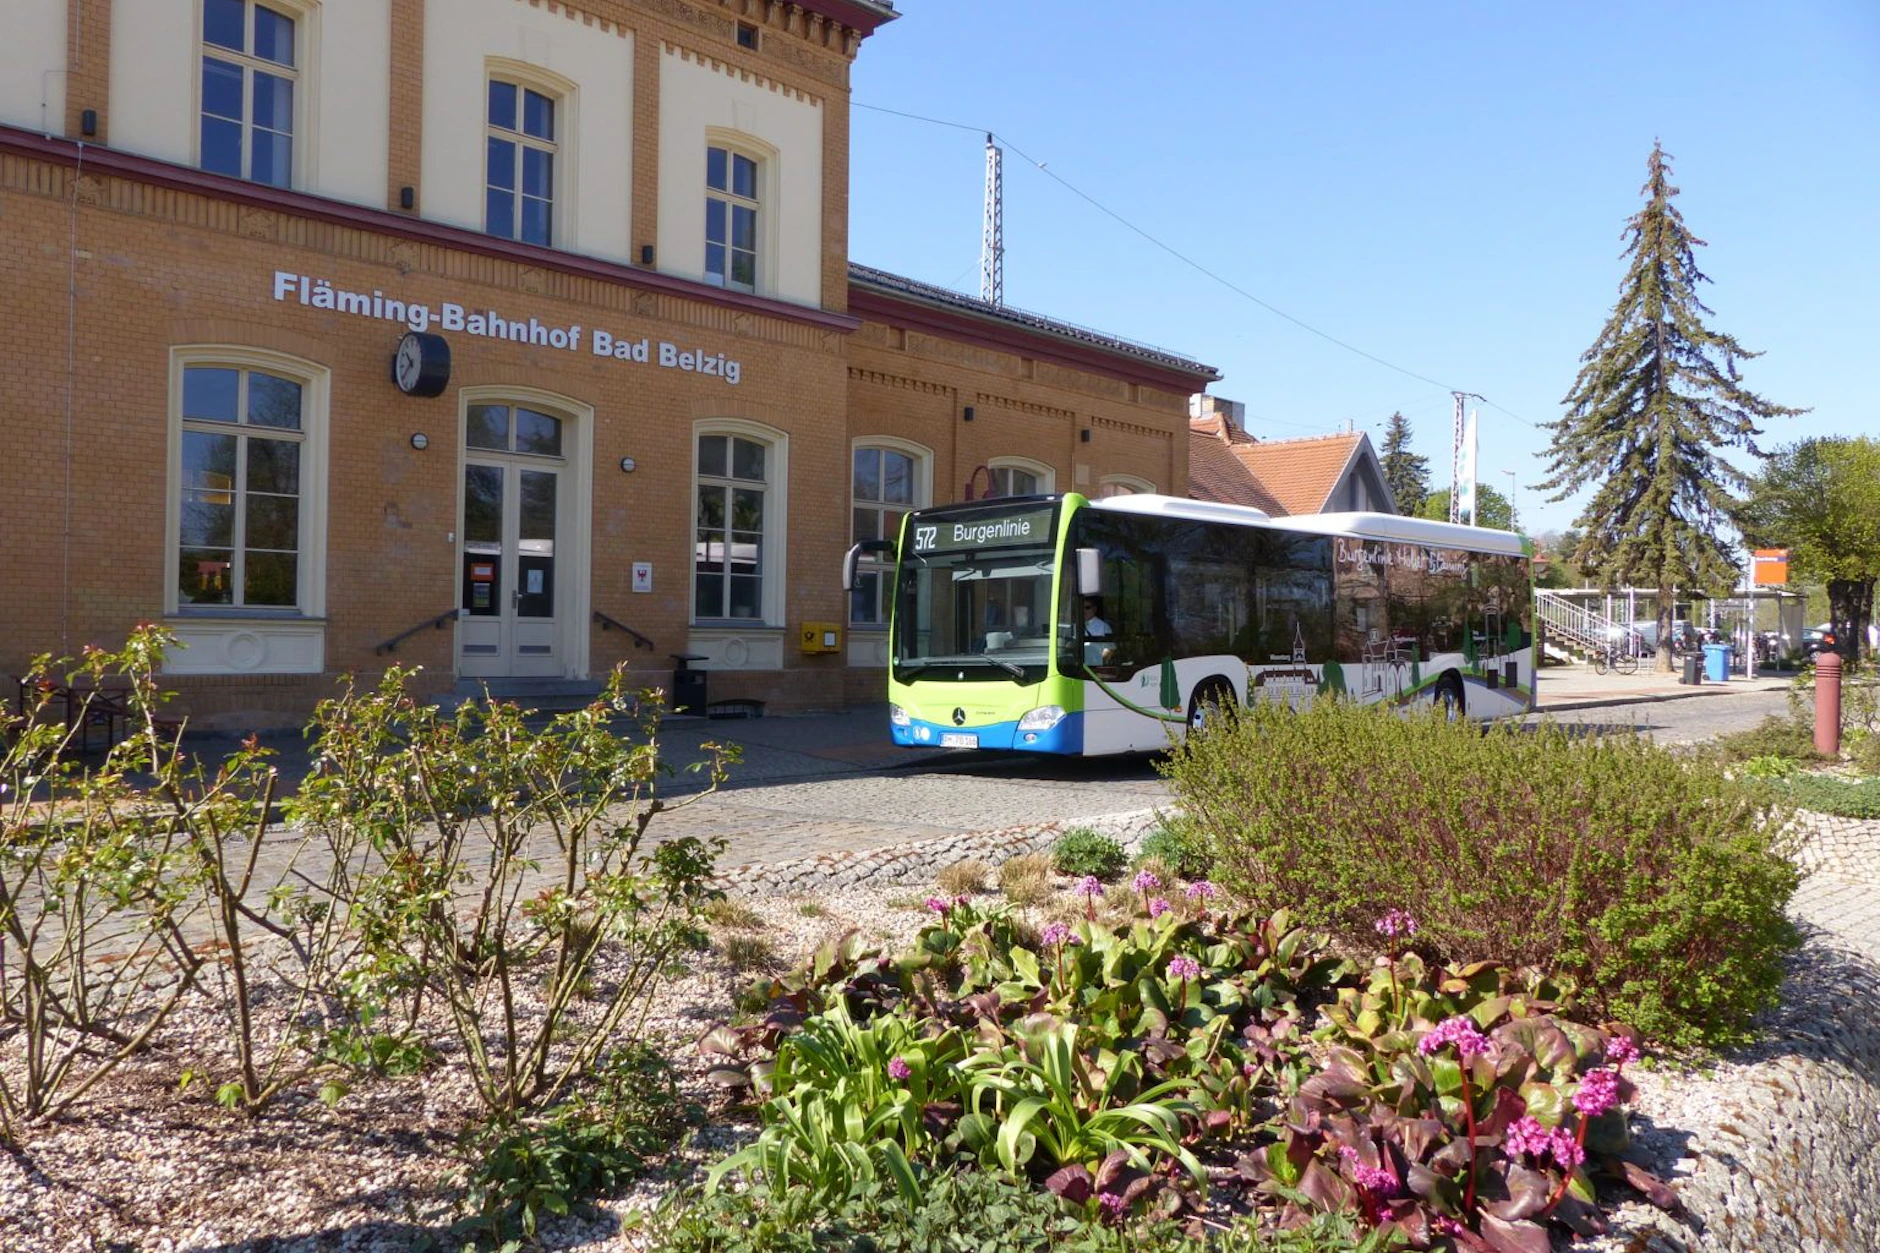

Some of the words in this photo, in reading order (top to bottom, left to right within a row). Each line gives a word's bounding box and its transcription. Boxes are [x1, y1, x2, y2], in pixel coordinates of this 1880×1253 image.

[273, 271, 581, 351] Fläming-Bahnhof
[593, 330, 649, 362] Bad
[659, 342, 740, 384] Belzig
[915, 526, 937, 550] 572
[953, 518, 1030, 543] Burgenlinie
